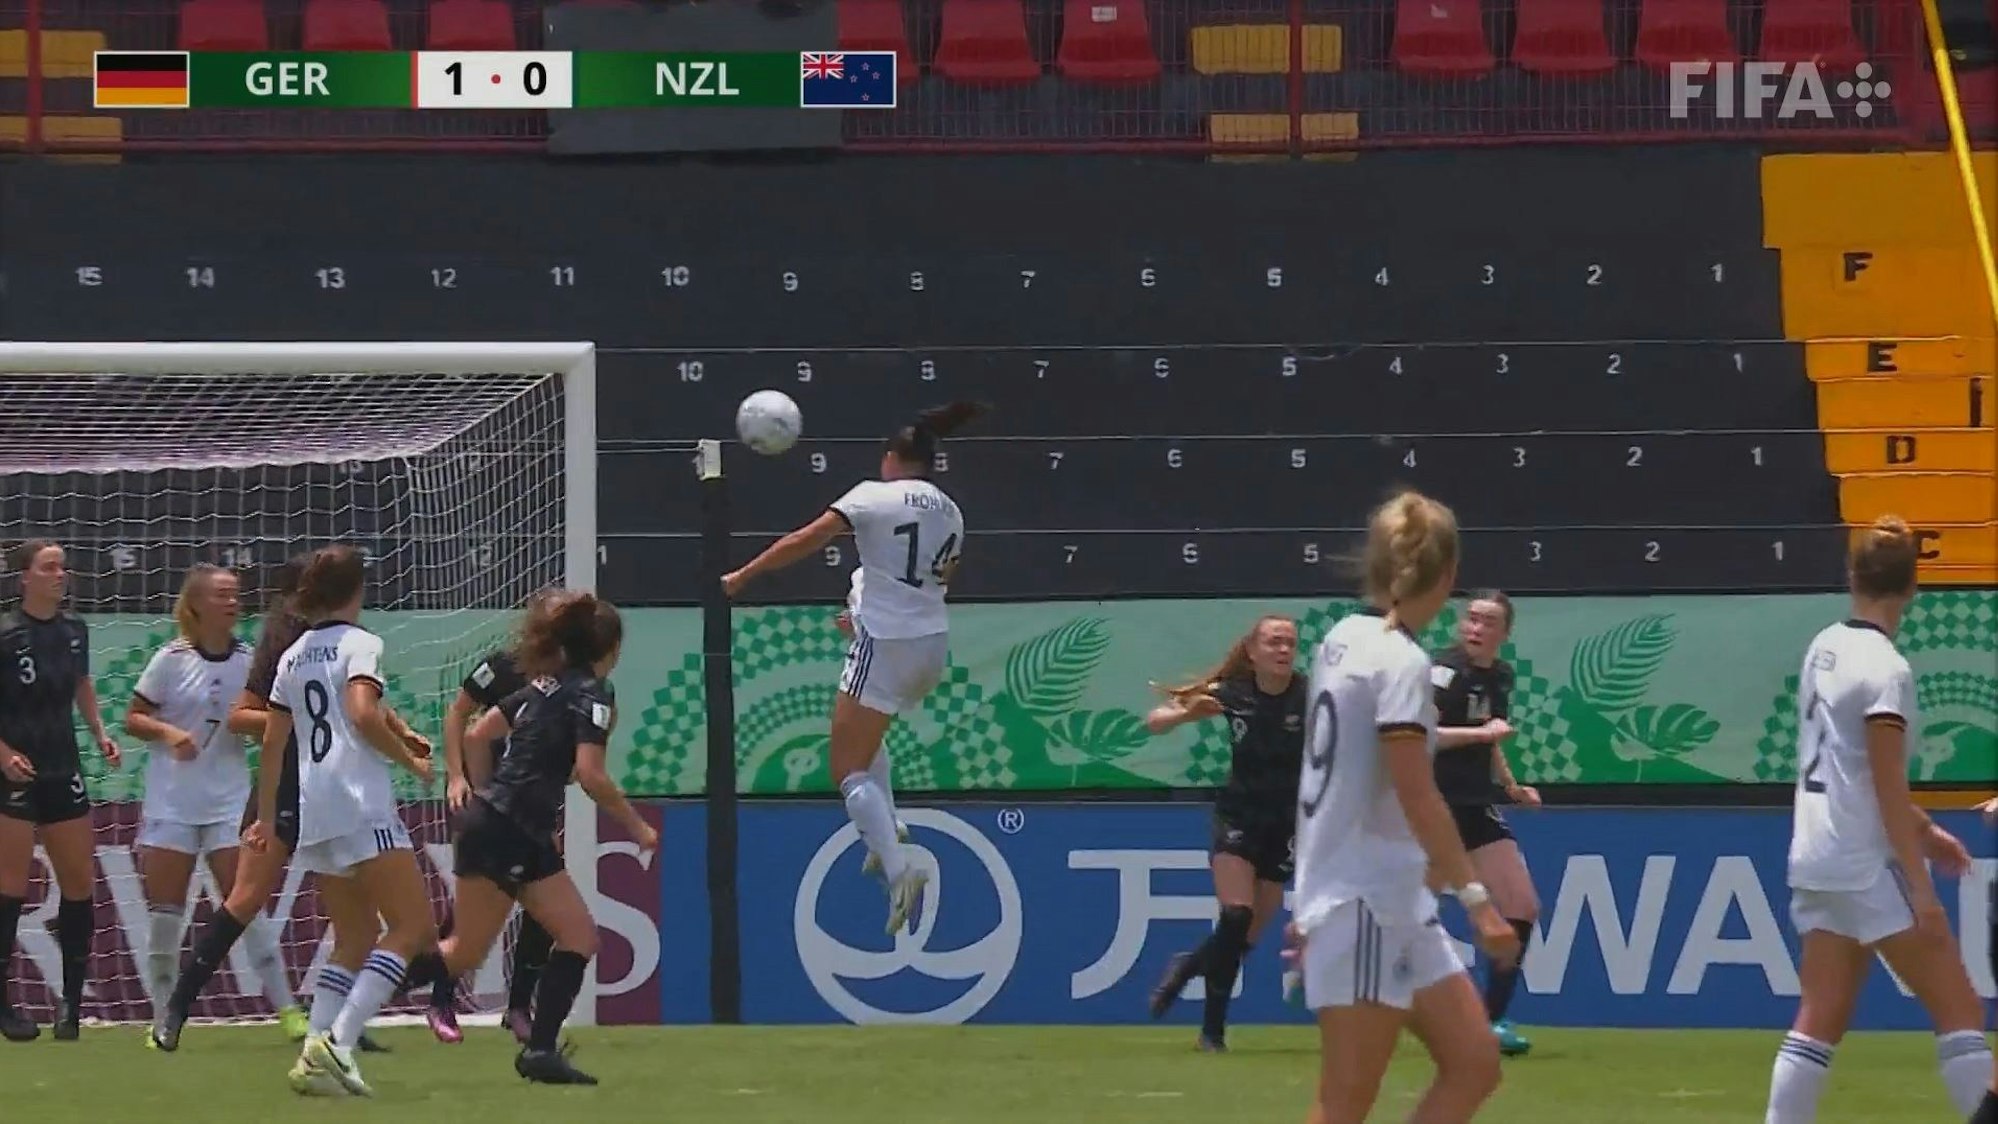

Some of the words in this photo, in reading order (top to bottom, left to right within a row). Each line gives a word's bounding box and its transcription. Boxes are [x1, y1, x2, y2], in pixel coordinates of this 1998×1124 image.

[76, 266, 102, 286] 15
[187, 267, 214, 287] 14
[316, 267, 345, 289] 13
[431, 268, 456, 288] 12
[550, 266, 574, 286] 11
[661, 266, 690, 287] 10
[783, 271, 799, 291] 9
[910, 271, 925, 291] 8
[1020, 270, 1036, 288] 7
[1141, 268, 1156, 287] 6
[1267, 268, 1282, 287] 5
[1374, 267, 1389, 286] 4
[1481, 264, 1495, 285] 3
[1587, 264, 1602, 285] 2
[1712, 263, 1723, 282] 1
[1843, 252, 1874, 282] F
[676, 361, 703, 382] 10
[797, 361, 813, 382] 9
[1033, 360, 1050, 379] 7
[1282, 357, 1297, 377] 5
[1389, 356, 1403, 375] 4
[1496, 353, 1509, 374] 3
[1606, 354, 1622, 375] 2
[1732, 353, 1744, 372] 1
[1868, 342, 1898, 373] E
[811, 452, 827, 473] 9
[1048, 451, 1064, 469] 7
[1167, 448, 1182, 468] 6
[1291, 449, 1306, 468] 5
[1403, 449, 1417, 468] 4
[1512, 447, 1526, 467] 3
[1626, 446, 1643, 467] 2
[1751, 446, 1763, 466] 1
[1887, 436, 1917, 464] D
[824, 546, 841, 567] 9
[1063, 545, 1078, 563] 7
[1182, 543, 1198, 564] 6
[1303, 543, 1319, 563] 5
[1529, 541, 1542, 562] 3
[1644, 541, 1660, 562] 2
[1772, 541, 1784, 561] 1
[894, 521, 957, 587] 14
[1916, 530, 1942, 560] C
[19, 656, 37, 685] 3
[203, 719, 222, 748] 7
[304, 679, 333, 763] 8
[1302, 689, 1338, 819] 9
